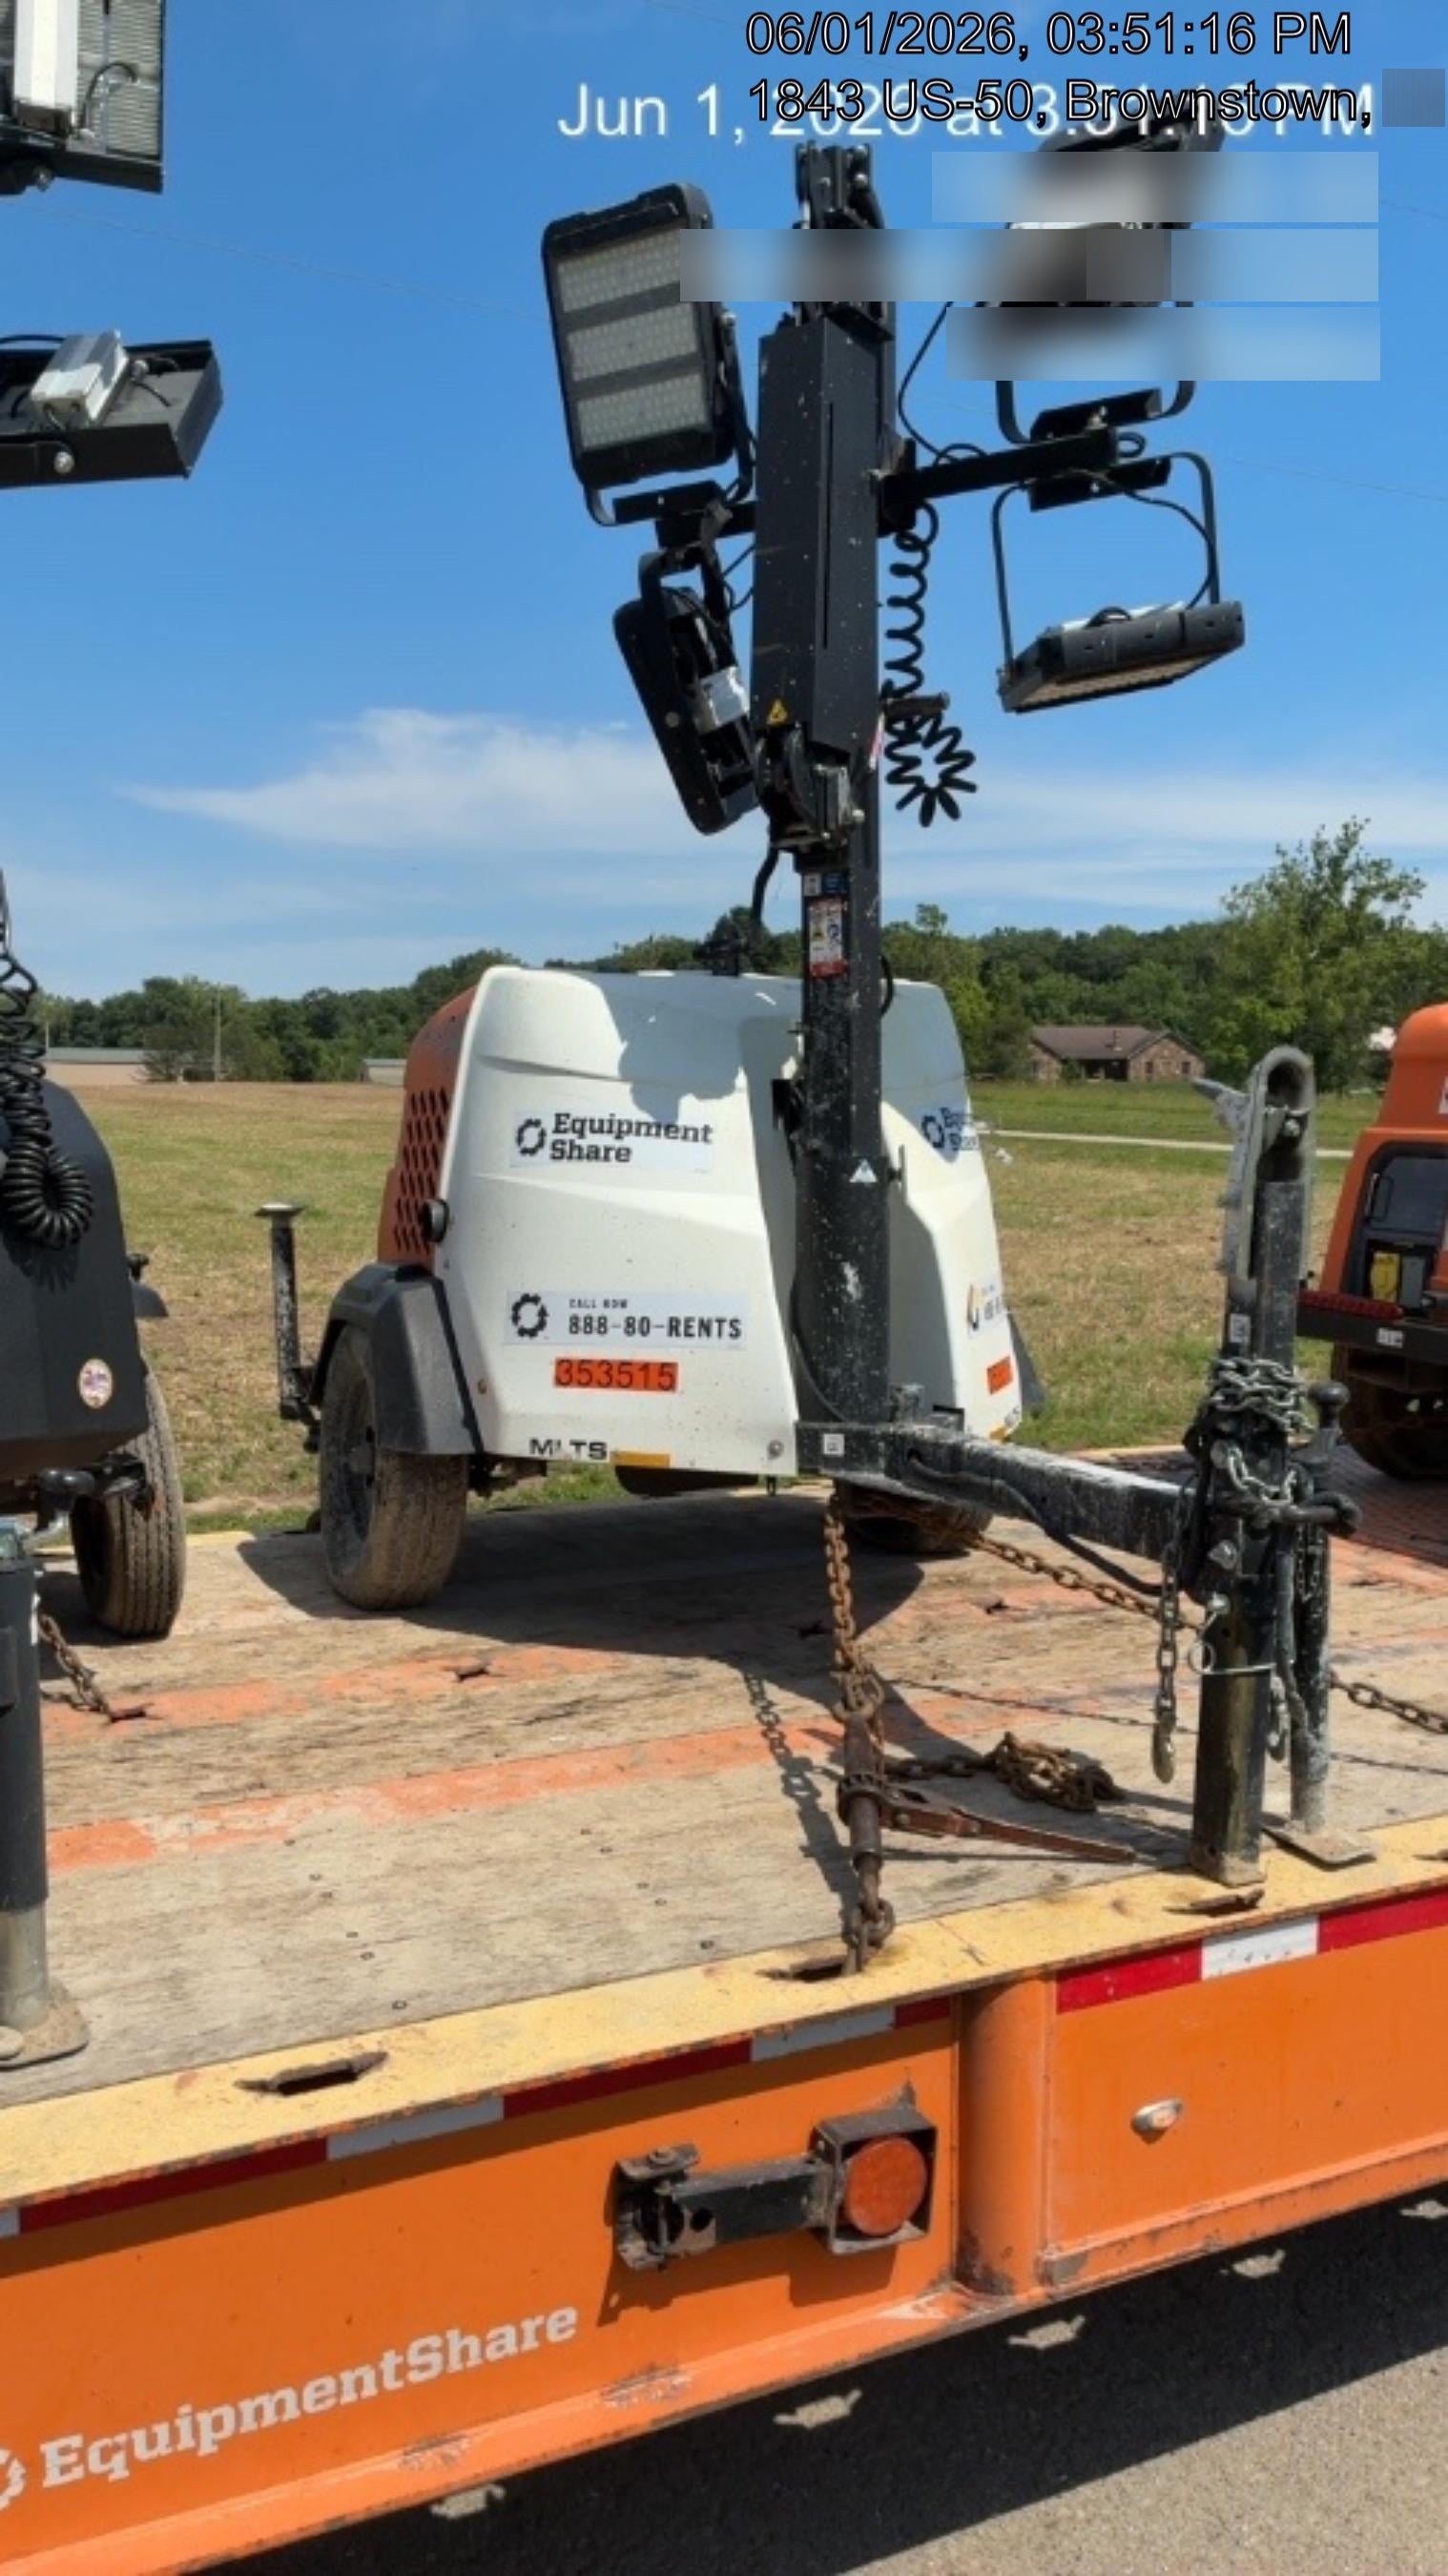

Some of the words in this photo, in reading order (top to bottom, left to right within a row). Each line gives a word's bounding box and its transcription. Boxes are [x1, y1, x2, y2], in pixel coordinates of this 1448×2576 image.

[551, 1112, 714, 1144] Equipment
[549, 1139, 632, 1163] Share
[569, 1315, 742, 1340] 888-80-RENTS
[555, 1359, 676, 1391] 353515
[40, 2306, 578, 2487] EquipmentShare
